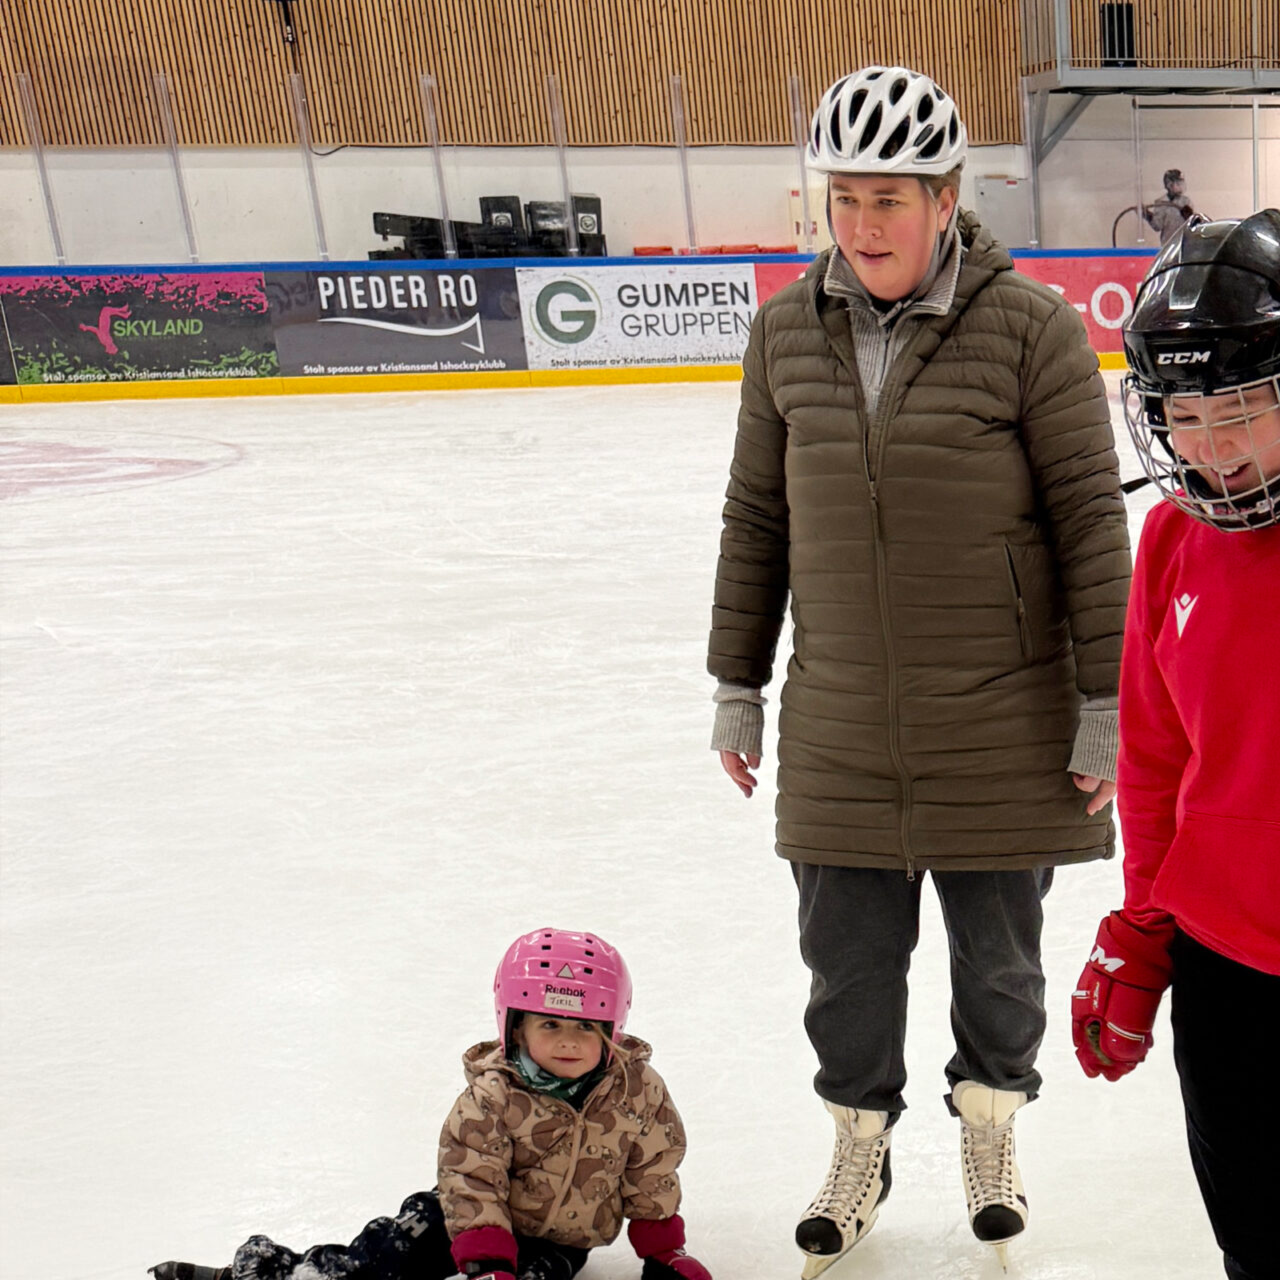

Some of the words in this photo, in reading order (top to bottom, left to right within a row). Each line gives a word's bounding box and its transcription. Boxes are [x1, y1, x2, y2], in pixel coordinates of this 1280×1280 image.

[318, 274, 428, 311] PIEDER
[438, 273, 479, 308] RO
[616, 281, 750, 308] GUMPEN
[113, 319, 203, 338] SKYLAND
[620, 309, 754, 338] GRUPPEN
[551, 358, 570, 367] Stolt
[573, 358, 607, 368] sponsor
[623, 355, 677, 364] Kristiansand
[680, 352, 741, 363] Ishockeyklubb
[1156, 351, 1211, 365] CCM
[43, 372, 66, 382] Stolt
[68, 373, 106, 383] sponsor
[125, 369, 185, 380] Kristiansand
[187, 366, 257, 378] Ishockeyklubb
[303, 364, 325, 374] Stolt
[327, 365, 364, 375] sponsor
[380, 361, 438, 372] Kristiansand
[440, 359, 506, 371] Ishockeyklubb
[545, 983, 586, 998] Reebok
